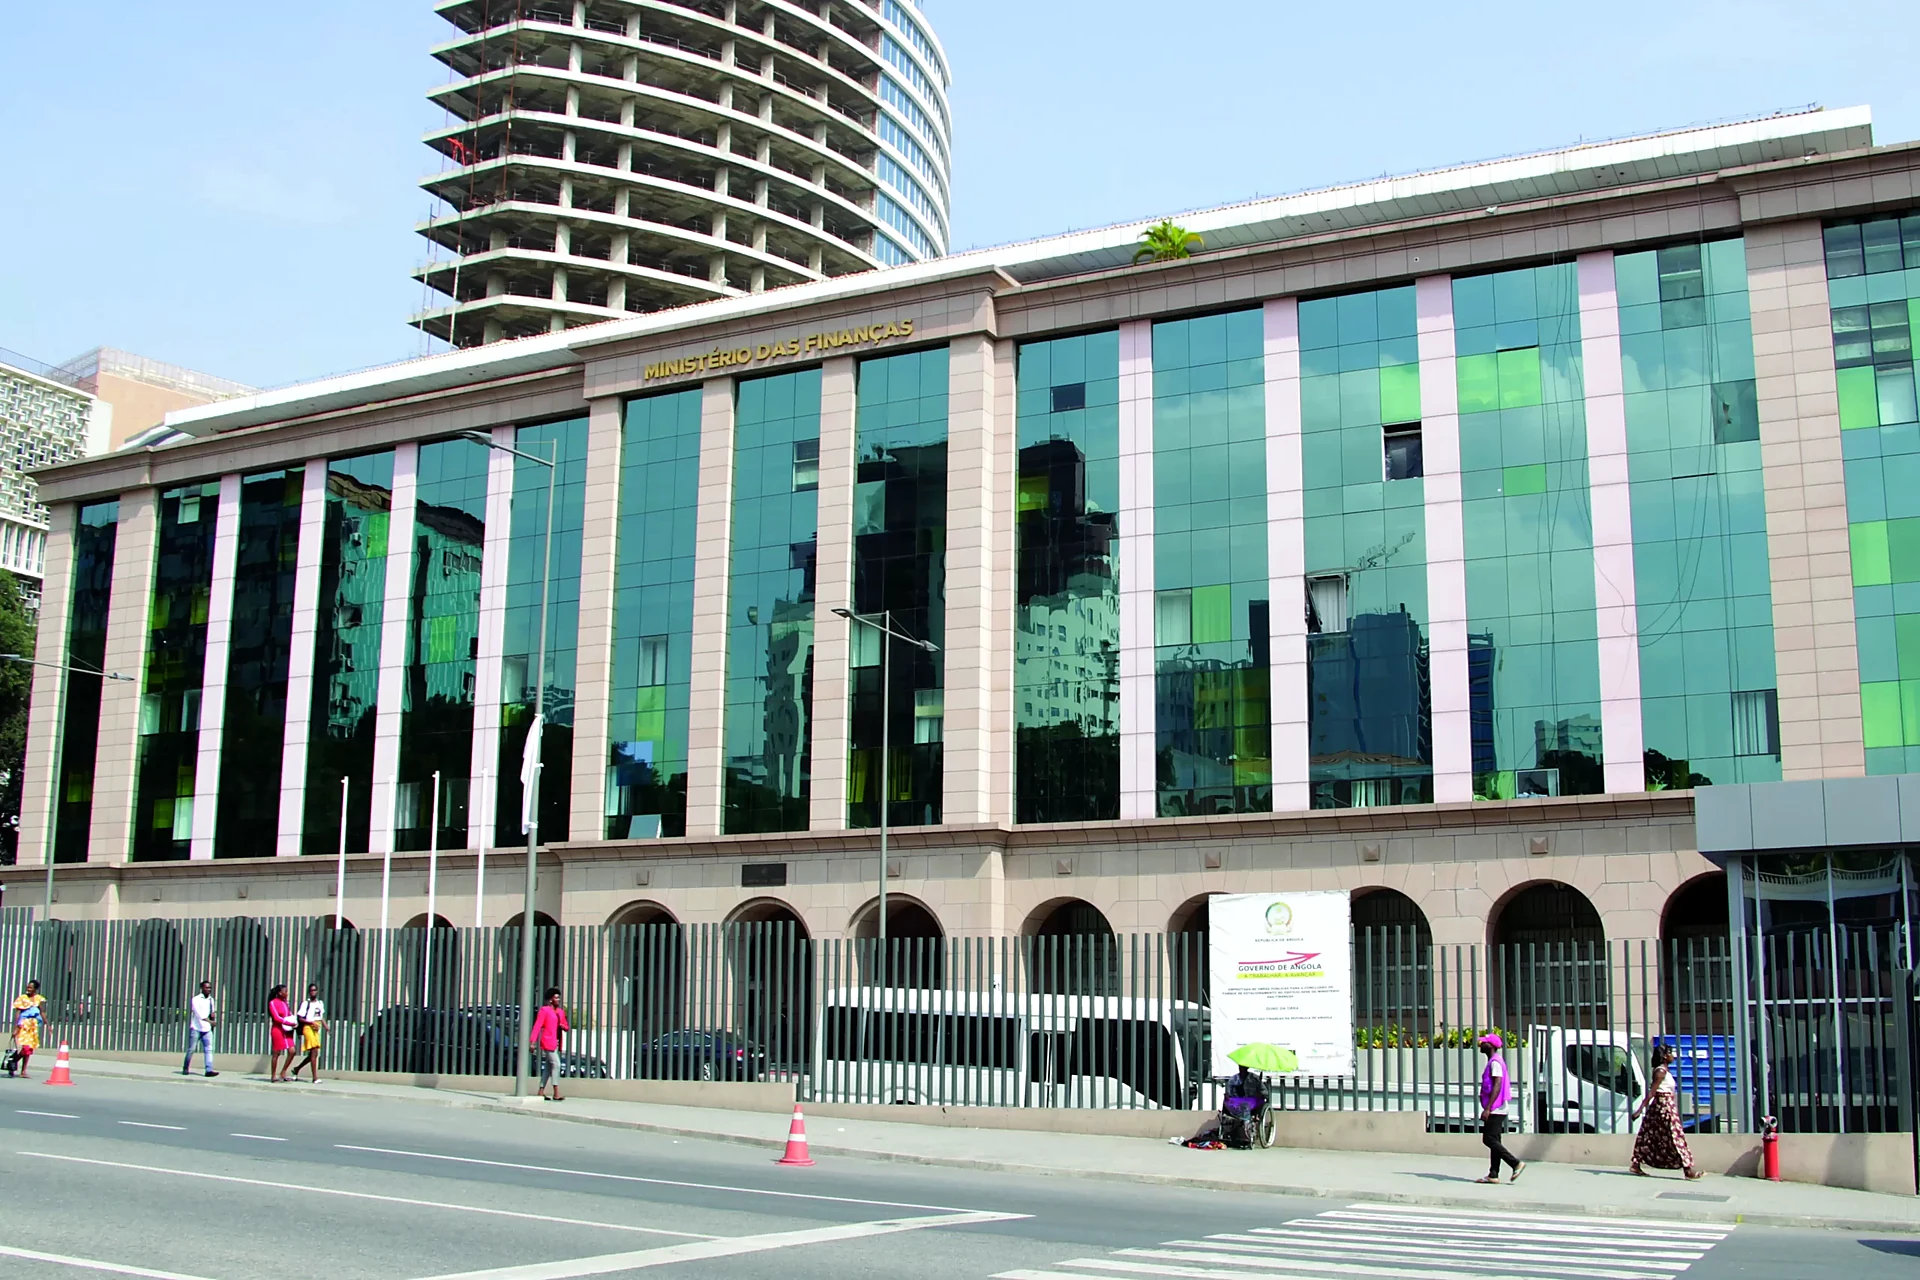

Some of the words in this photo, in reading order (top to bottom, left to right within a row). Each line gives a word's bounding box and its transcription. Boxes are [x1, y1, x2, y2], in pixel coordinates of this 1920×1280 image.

[644, 346, 752, 381] MINISTÉRIO
[756, 339, 800, 360] DAS
[805, 318, 914, 352] FINANÇAS
[1238, 964, 1276, 972] GOVERNO
